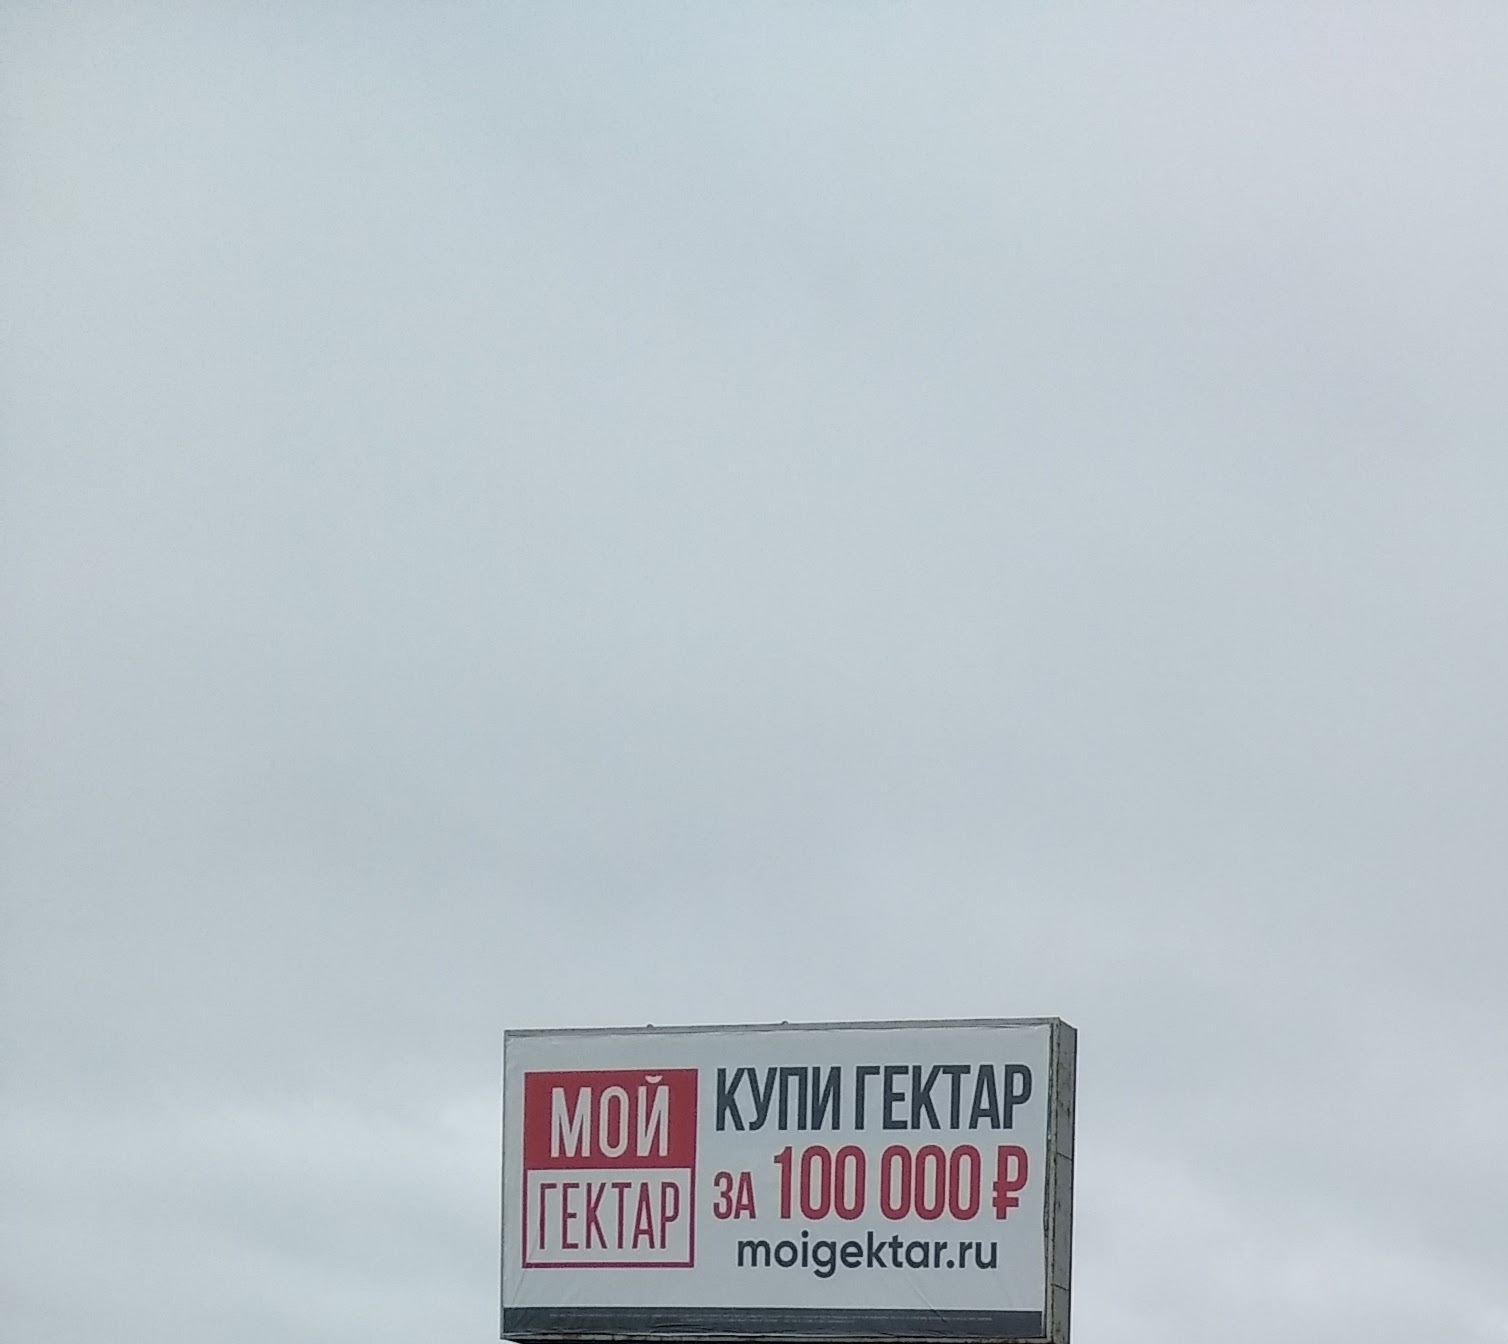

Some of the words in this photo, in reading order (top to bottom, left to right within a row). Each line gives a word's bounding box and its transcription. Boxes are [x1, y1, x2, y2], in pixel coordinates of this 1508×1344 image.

[549, 1074, 670, 1158] МОЙ
[715, 1065, 842, 1132] КУПИ
[854, 1063, 1033, 1131] ГЕКТАР
[537, 1181, 681, 1250] ГЕКТАР
[712, 1171, 757, 1220] ЗА
[772, 1144, 867, 1221] 100
[879, 1144, 982, 1221] 000
[736, 1229, 999, 1279] moigektar.ru
